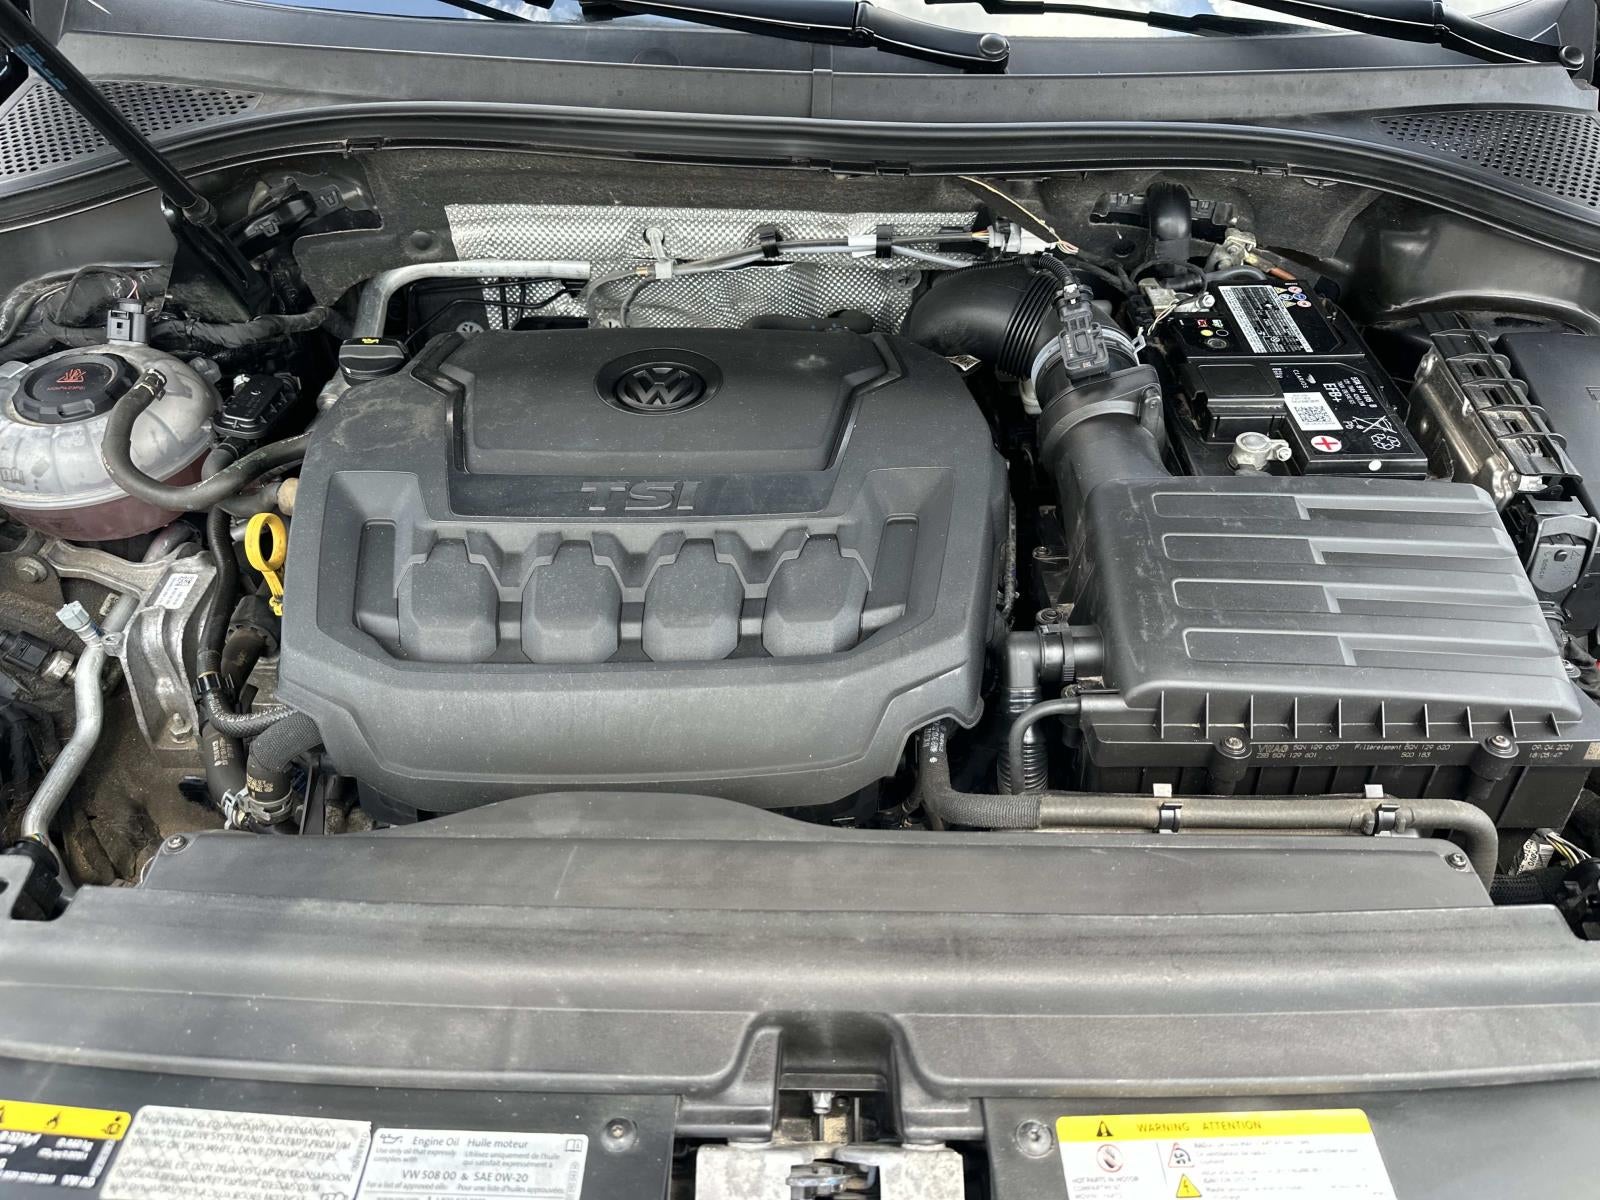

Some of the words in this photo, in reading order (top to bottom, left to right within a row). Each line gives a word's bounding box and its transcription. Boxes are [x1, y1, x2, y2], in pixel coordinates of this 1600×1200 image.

[1293, 369, 1309, 389] CLARIOS
[1323, 383, 1342, 403] EFB+
[581, 481, 702, 511] TSI
[1258, 744, 1289, 753] VWAG
[283, 1124, 336, 1137] PERMANENT
[1136, 1121, 1190, 1133] WARNING
[1202, 1120, 1262, 1131] ATTENTION
[210, 1131, 243, 1142] SYSTEM
[244, 1133, 265, 1145] AND
[274, 1136, 308, 1148] EXEMPT
[308, 1138, 335, 1149] FROM
[412, 1136, 444, 1148] Engine
[446, 1137, 459, 1146] Oil
[467, 1138, 491, 1148] Huile
[493, 1140, 528, 1149] moteur
[402, 1169, 421, 1179] VW
[422, 1170, 441, 1180] 508
[442, 1171, 457, 1180] 00
[461, 1173, 470, 1181] &
[473, 1172, 494, 1182] SAE
[495, 1172, 529, 1183] 0W-20
